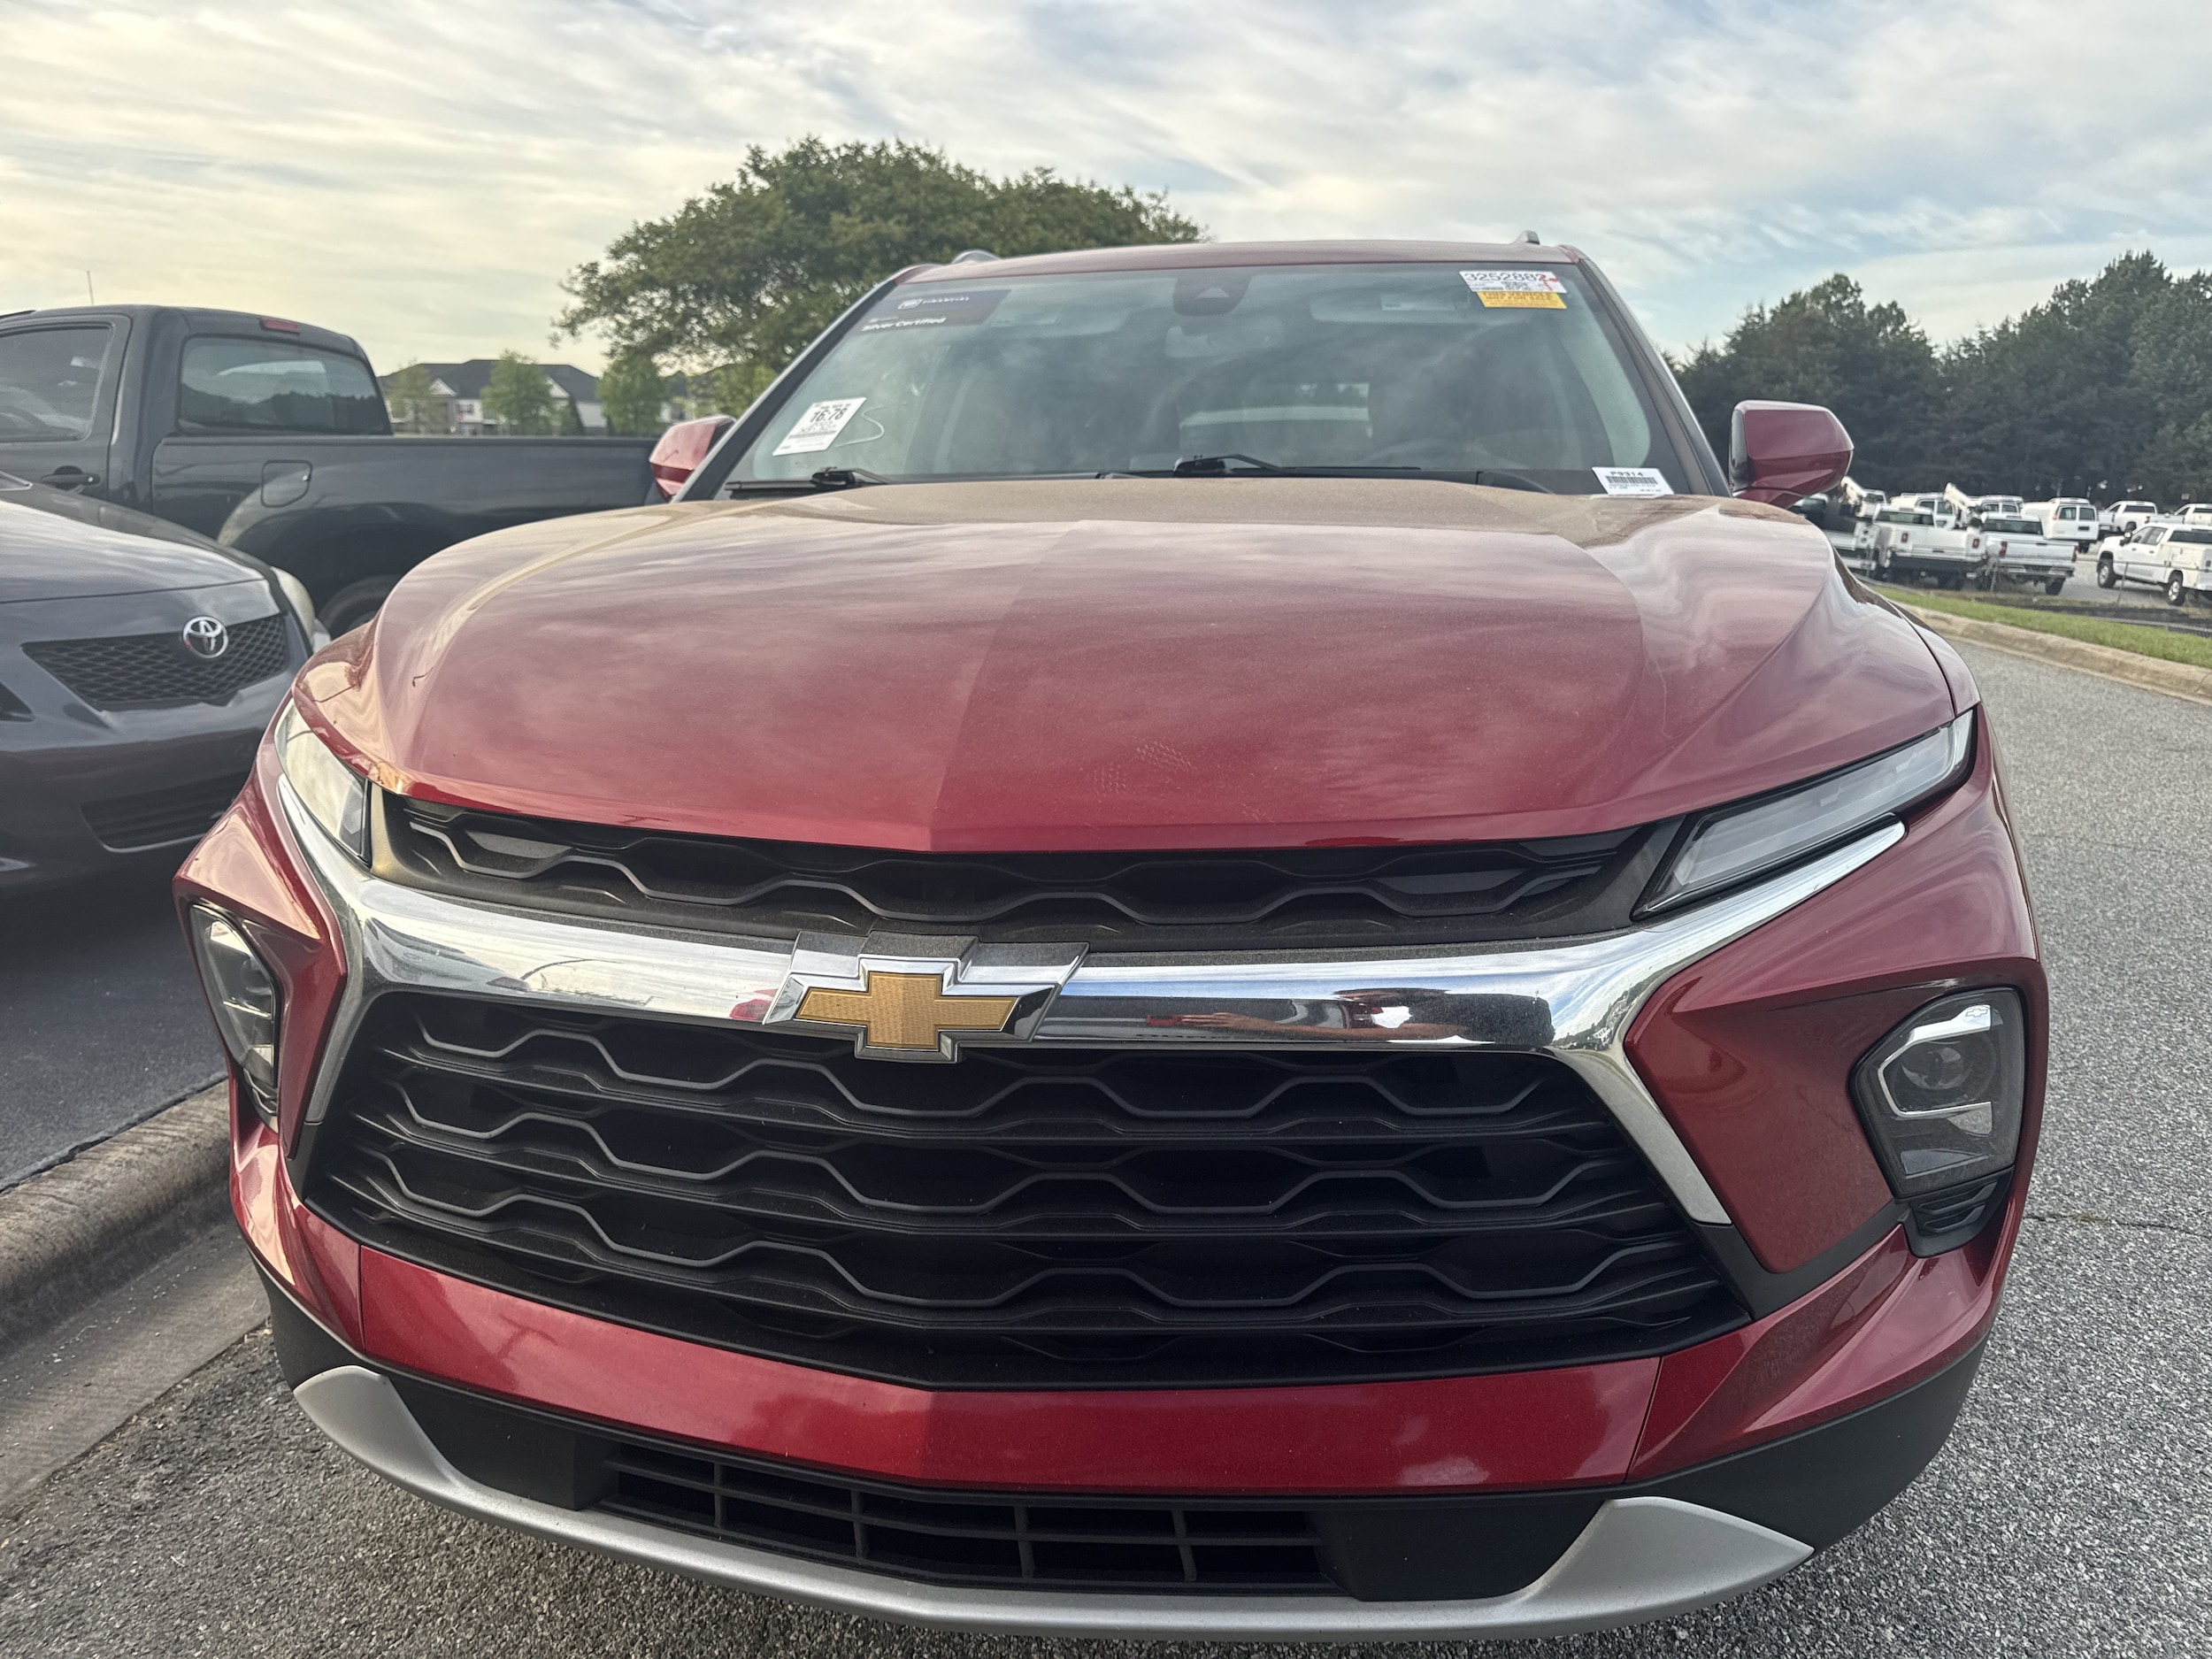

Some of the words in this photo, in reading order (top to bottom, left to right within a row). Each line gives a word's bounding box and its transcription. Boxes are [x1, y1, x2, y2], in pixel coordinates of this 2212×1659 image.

[861, 323, 894, 332] Silver
[895, 317, 947, 327] Certified
[810, 407, 848, 423] 16:78
